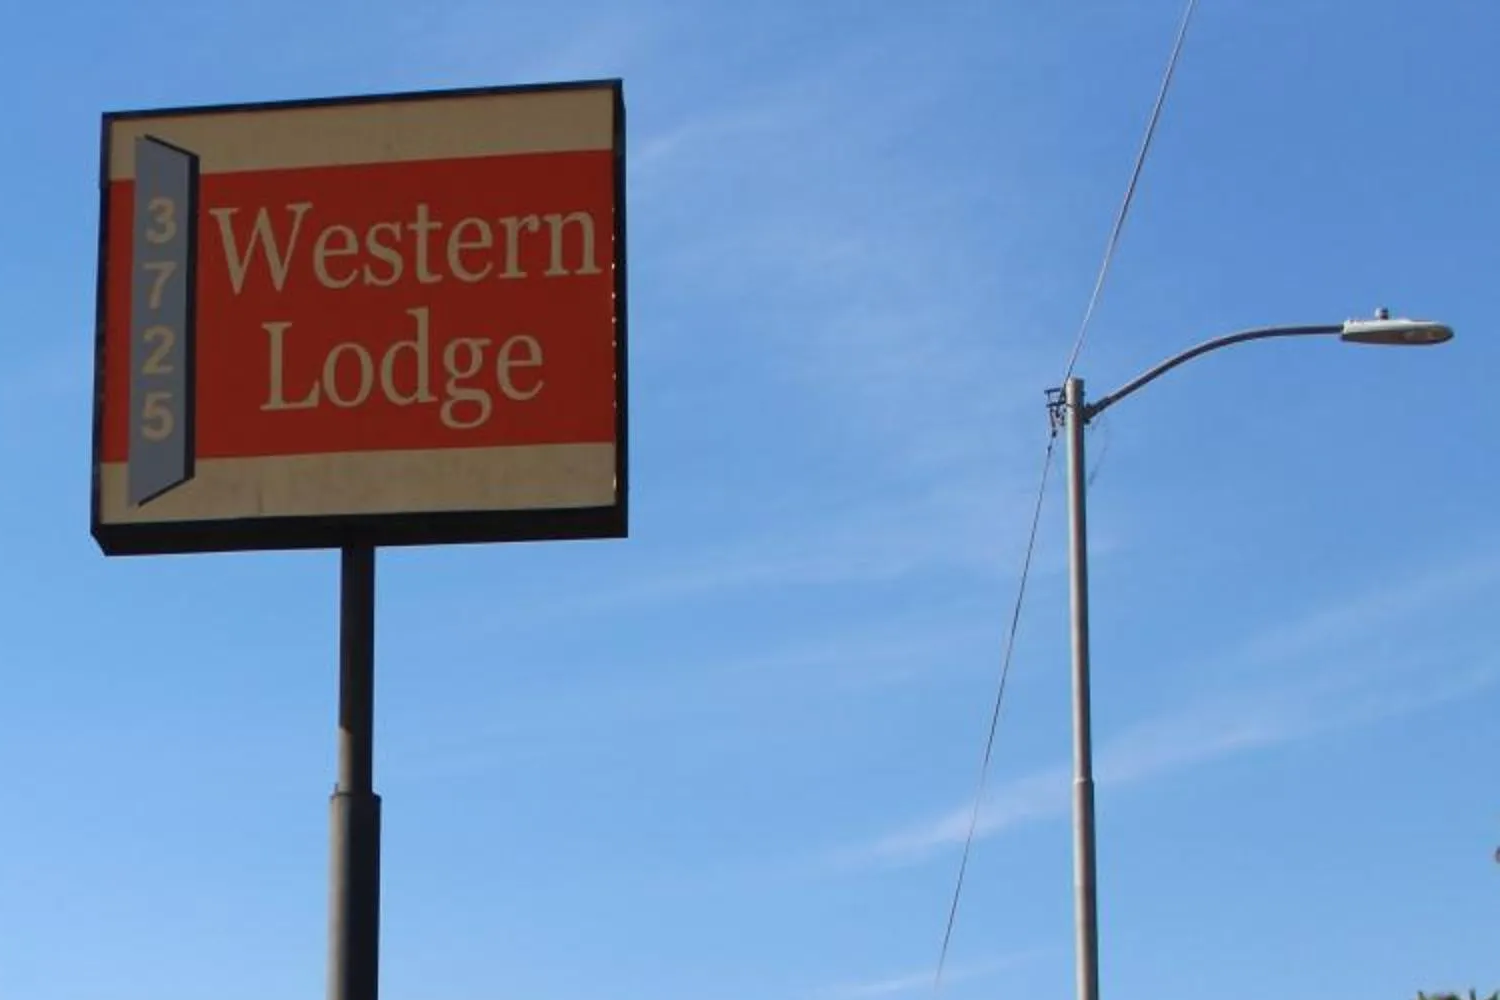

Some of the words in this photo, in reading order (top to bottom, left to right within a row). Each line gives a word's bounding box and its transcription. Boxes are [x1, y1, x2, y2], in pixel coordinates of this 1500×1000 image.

[209, 200, 603, 296] Western
[140, 197, 178, 442] 3725
[259, 305, 545, 430] Lodge
